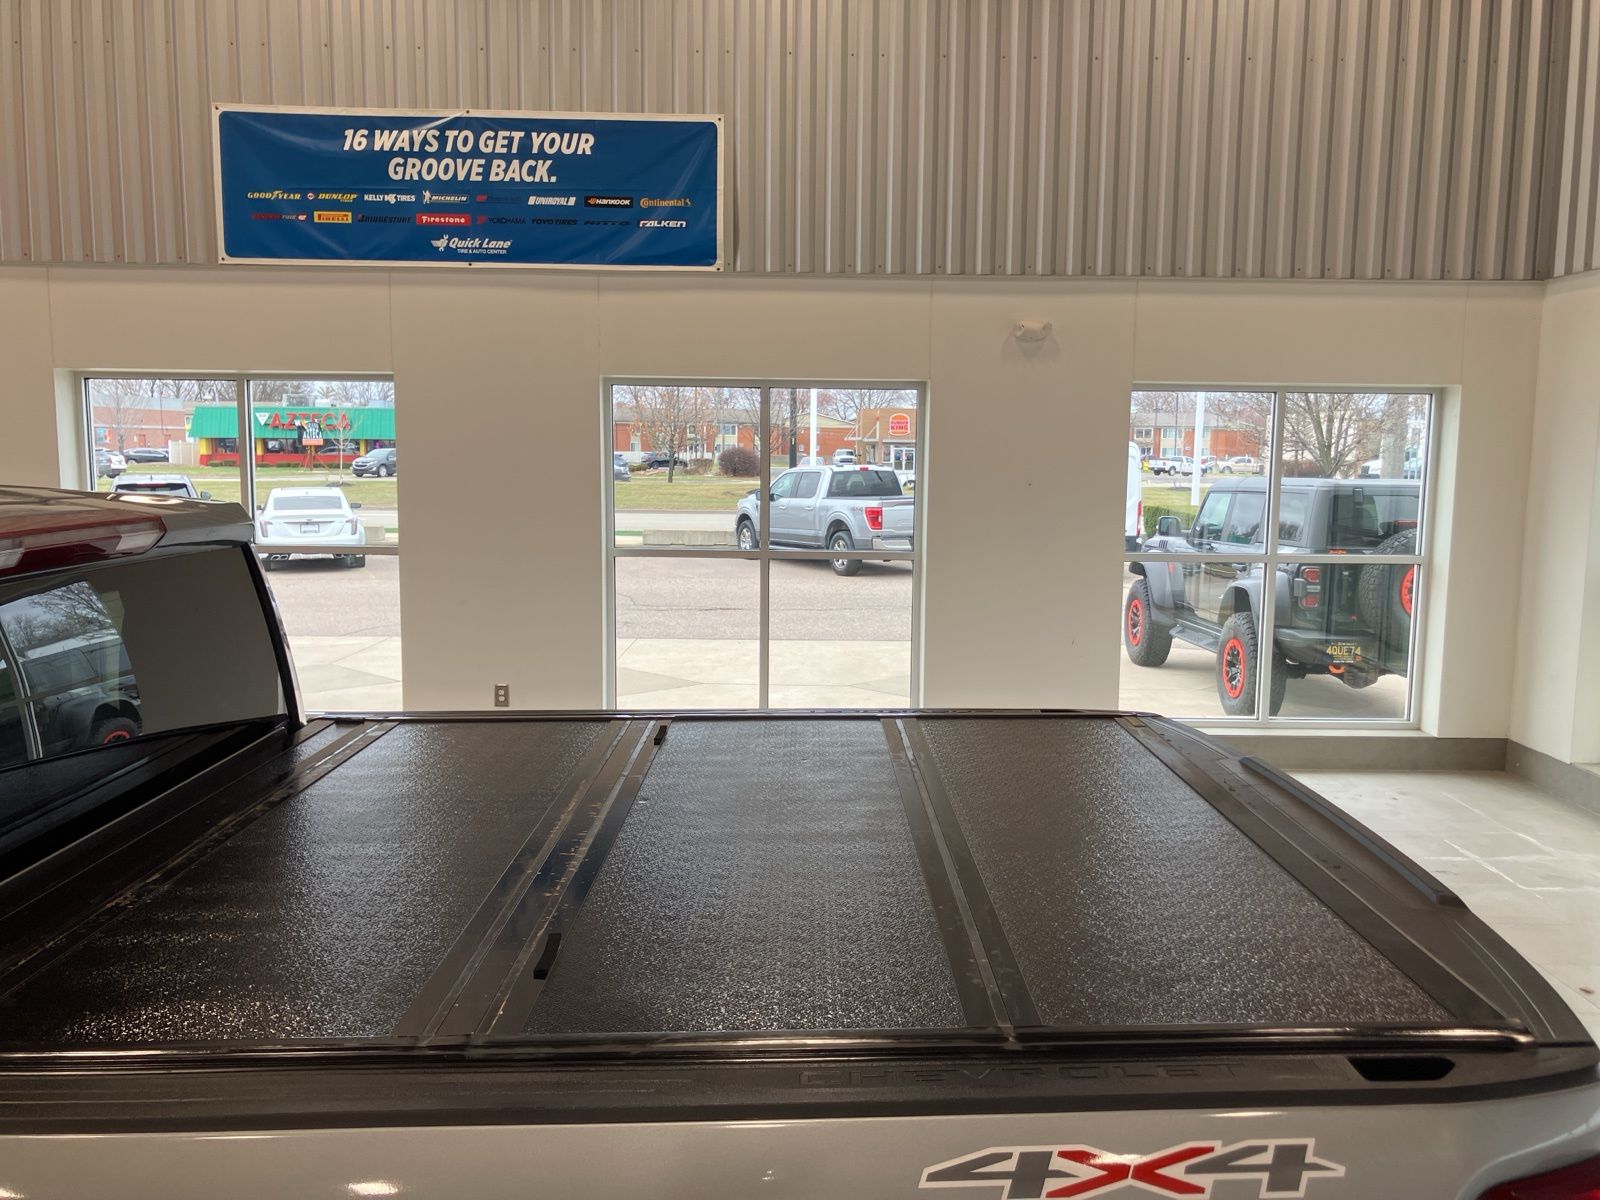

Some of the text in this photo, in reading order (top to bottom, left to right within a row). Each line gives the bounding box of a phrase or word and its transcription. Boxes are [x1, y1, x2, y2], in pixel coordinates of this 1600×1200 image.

[343, 129, 595, 155] 16 WAYS TO GET YOUR
[388, 157, 557, 183] GROOVE BACK.
[247, 190, 301, 200] GOODYEAR
[535, 197, 569, 206] UNIROYAL
[640, 197, 685, 209] Continental
[422, 215, 466, 224] Firestone
[640, 220, 687, 228] FALKEN
[449, 237, 511, 249] Quick Lane
[799, 1062, 1246, 1086] CHEVROLET
